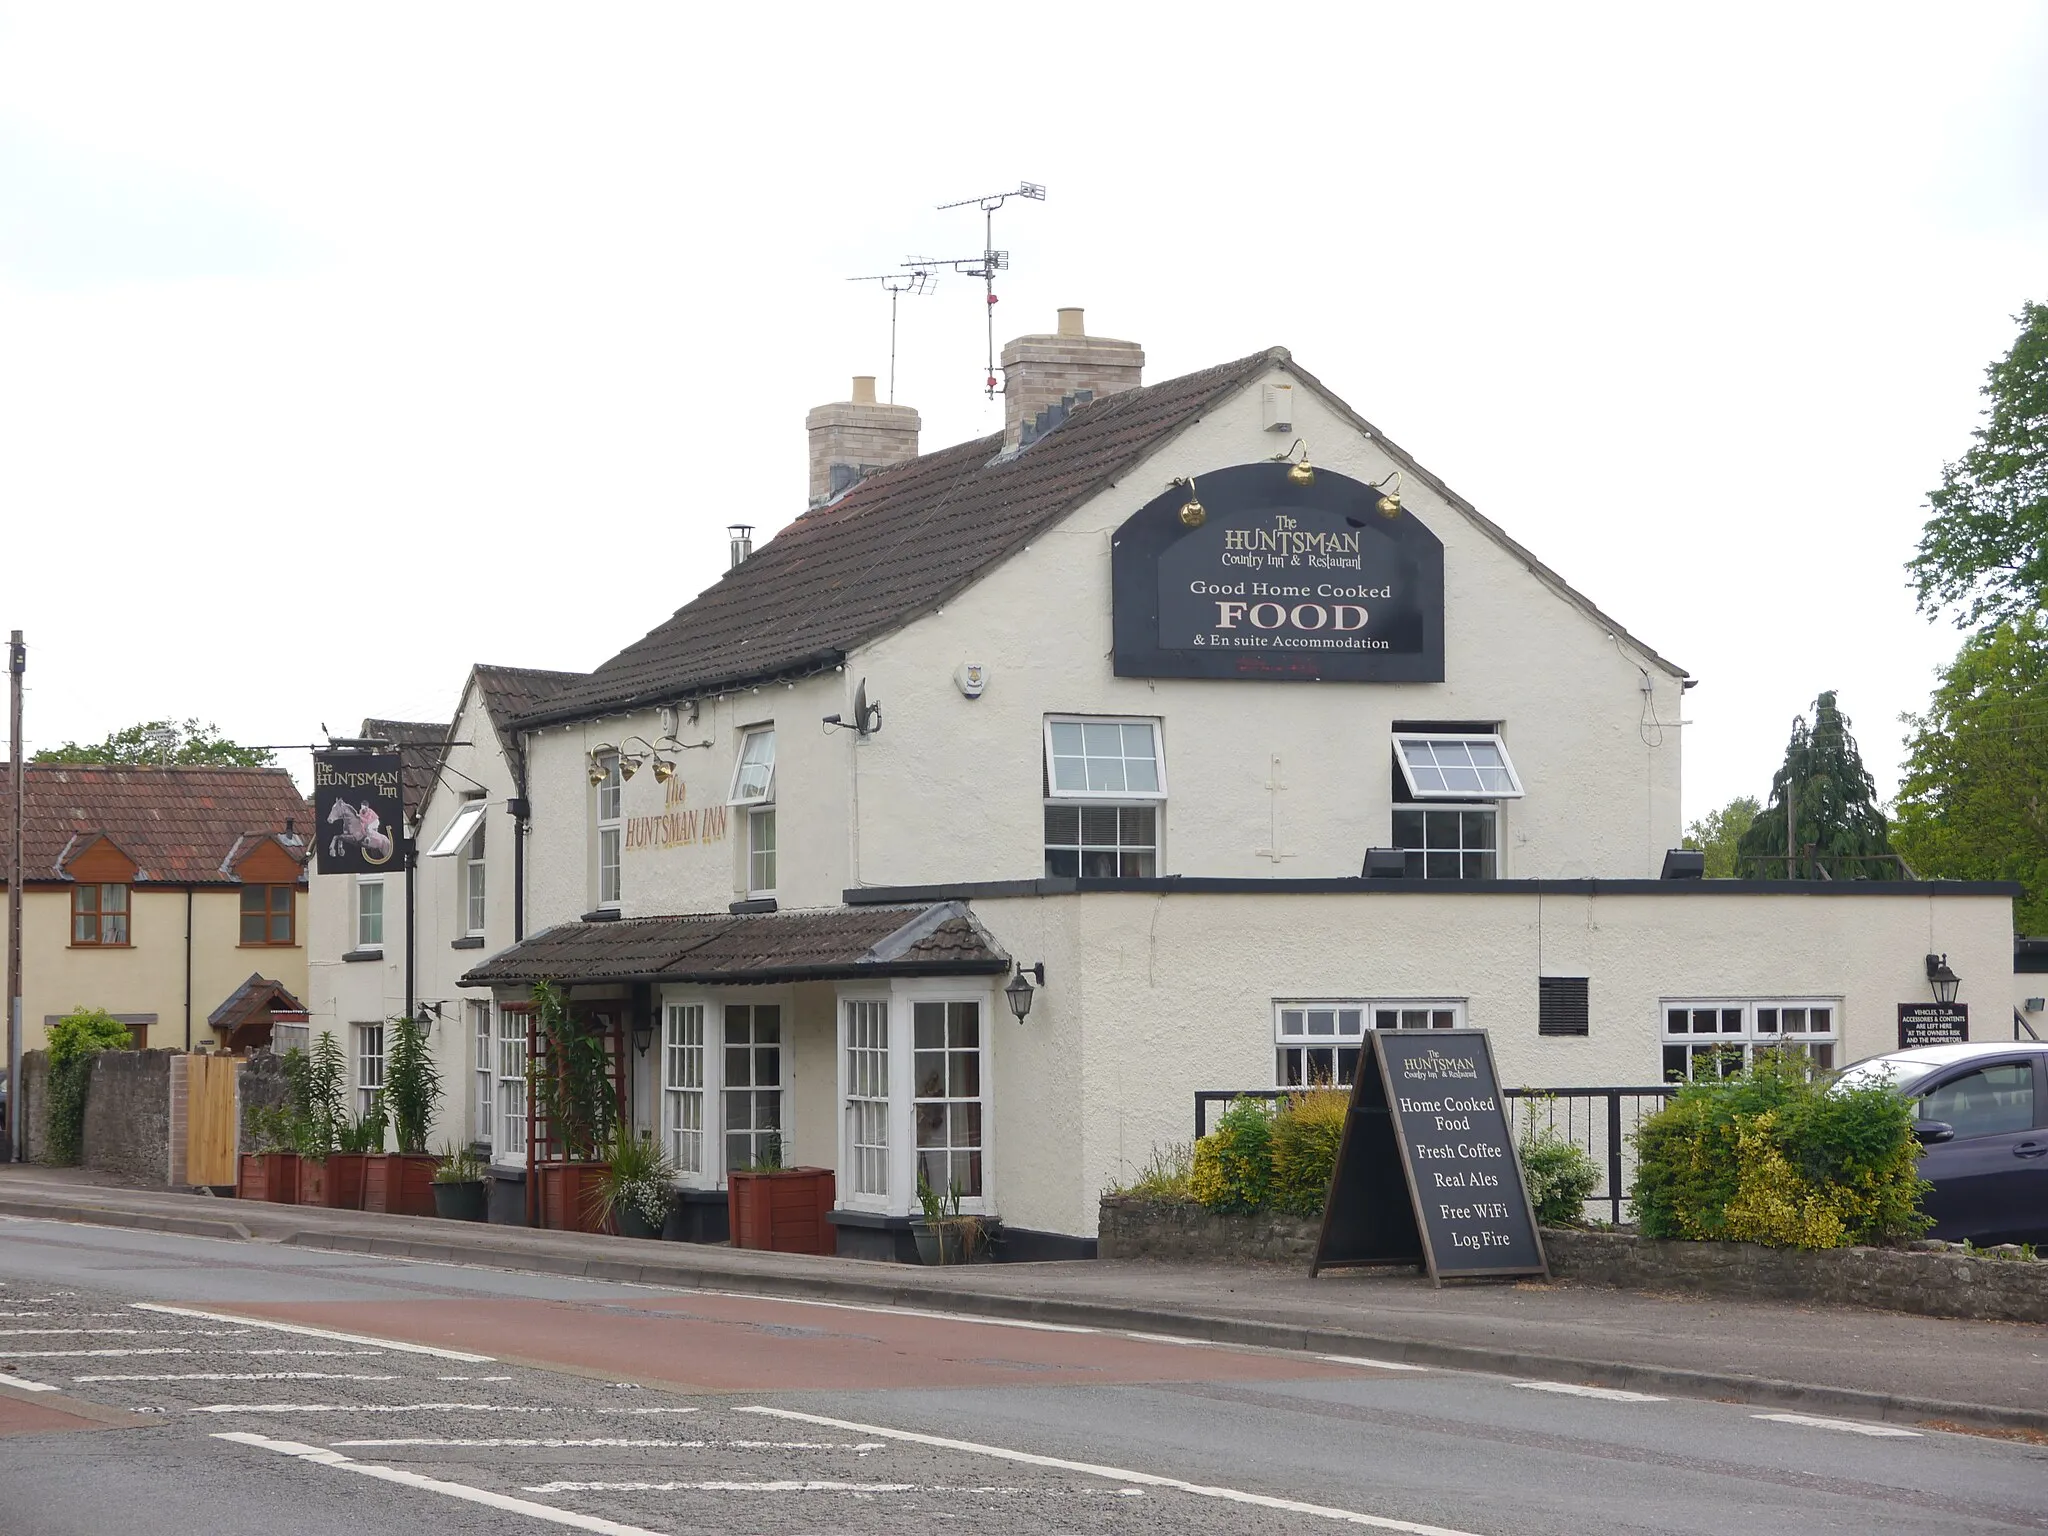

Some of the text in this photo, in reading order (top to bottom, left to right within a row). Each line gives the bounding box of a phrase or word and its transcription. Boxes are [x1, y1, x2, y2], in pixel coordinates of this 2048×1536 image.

[1276, 515, 1297, 531] The
[1225, 528, 1361, 556] HUNTSMAN
[1222, 551, 1362, 571] Country Inn & Restaurant
[1190, 580, 1391, 598] Good Home Cooked
[1214, 601, 1370, 631] FOOD
[1193, 633, 1390, 649] & En suite Accommodation
[315, 761, 333, 775] The
[316, 771, 399, 788] HUNTSMAN
[378, 784, 399, 799] Inn
[665, 773, 687, 805] The
[625, 805, 728, 849] HUNTSMAN INN
[1427, 1049, 1440, 1058] The
[1404, 1057, 1475, 1073] HUNTSMAN
[1404, 1070, 1477, 1080] Country Inn & Restaurant
[1400, 1097, 1495, 1112] Home Cooked
[1435, 1116, 1470, 1131] Food
[1416, 1143, 1502, 1159] Fresh Coffee
[1434, 1171, 1499, 1187] Real Ales
[1440, 1203, 1509, 1219] Free WiFi
[1451, 1231, 1510, 1249] Log Fire
